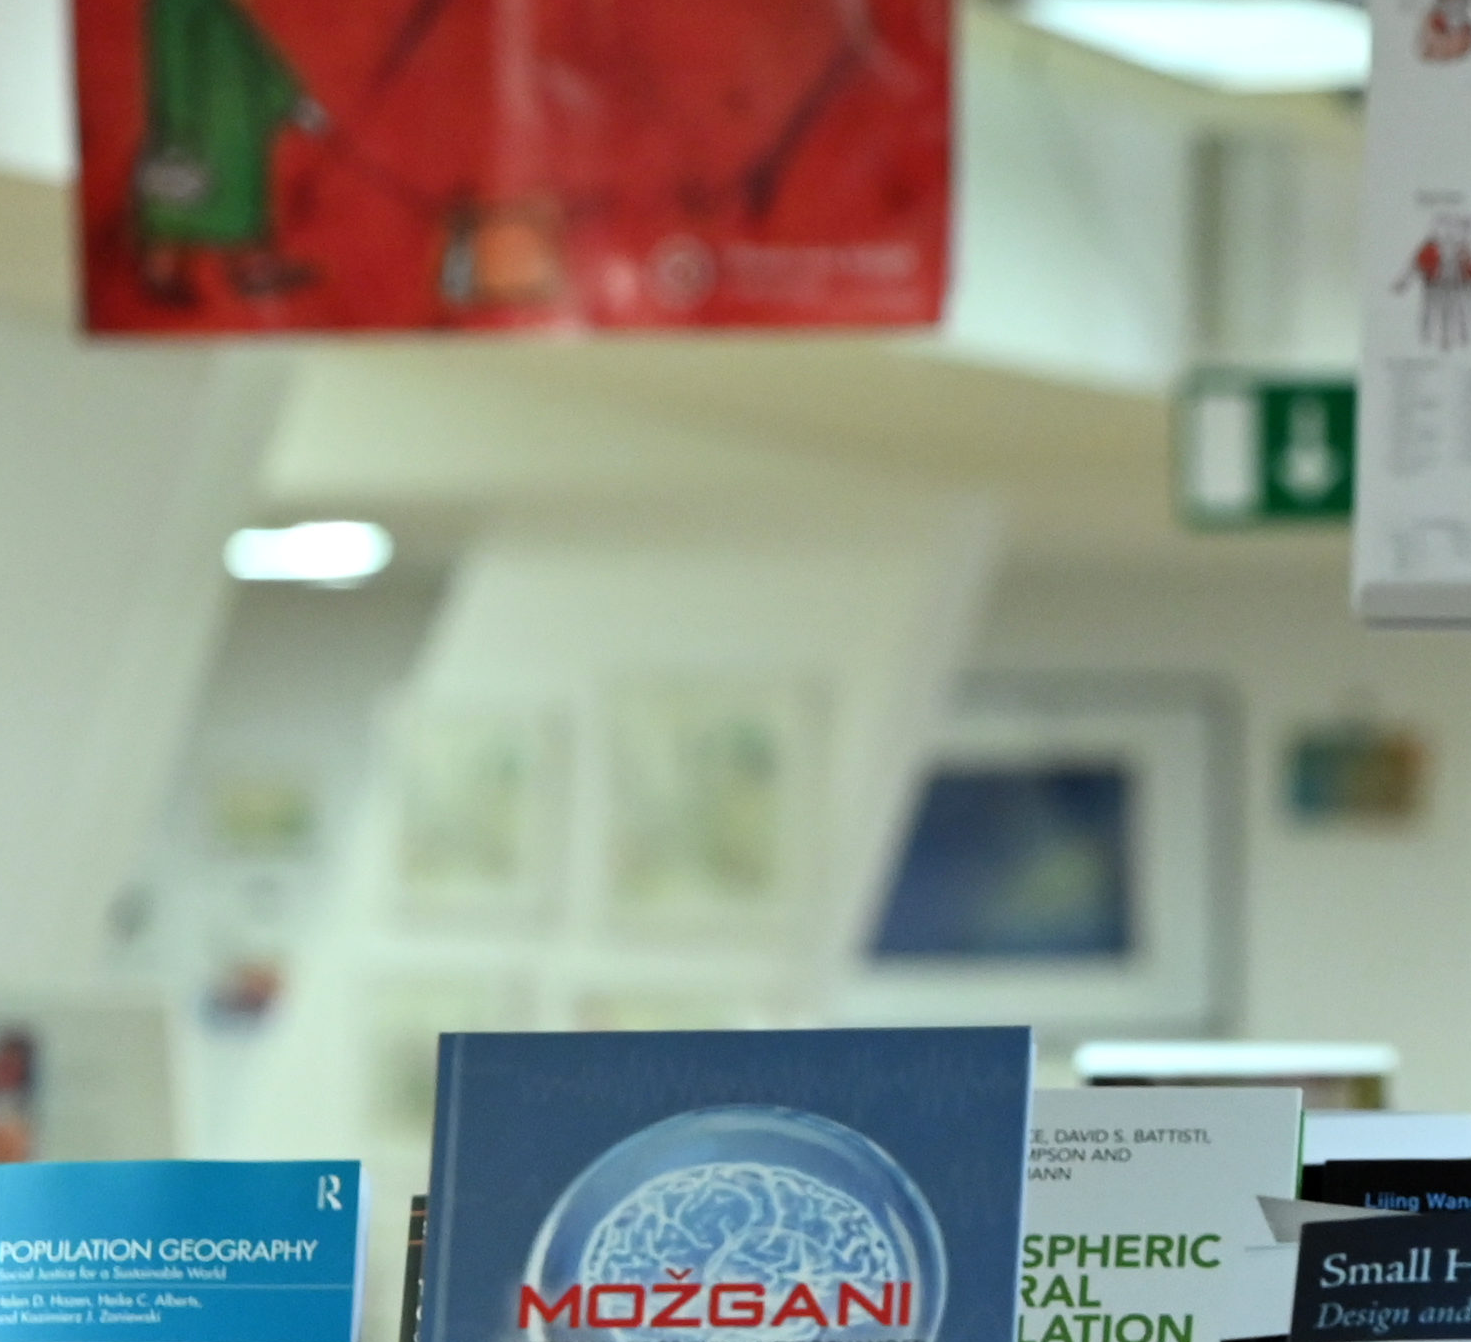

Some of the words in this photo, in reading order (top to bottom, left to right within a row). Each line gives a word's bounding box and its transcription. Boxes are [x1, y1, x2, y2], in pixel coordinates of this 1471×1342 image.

[1054, 1129, 1109, 1144] DAVID
[1091, 1148, 1132, 1162] AND
[159, 1238, 319, 1261] GEOGRAPHY
[1023, 1234, 1222, 1269] SPHERIC
[37, 1266, 77, 1281] Justice
[79, 1266, 99, 1280] for
[100, 1269, 111, 1280] a
[112, 1265, 184, 1280] Sustainable
[186, 1265, 228, 1280] World
[1320, 1247, 1432, 1289] Small
[518, 1268, 912, 1329] MOŽGANI
[1315, 1301, 1410, 1334] Design
